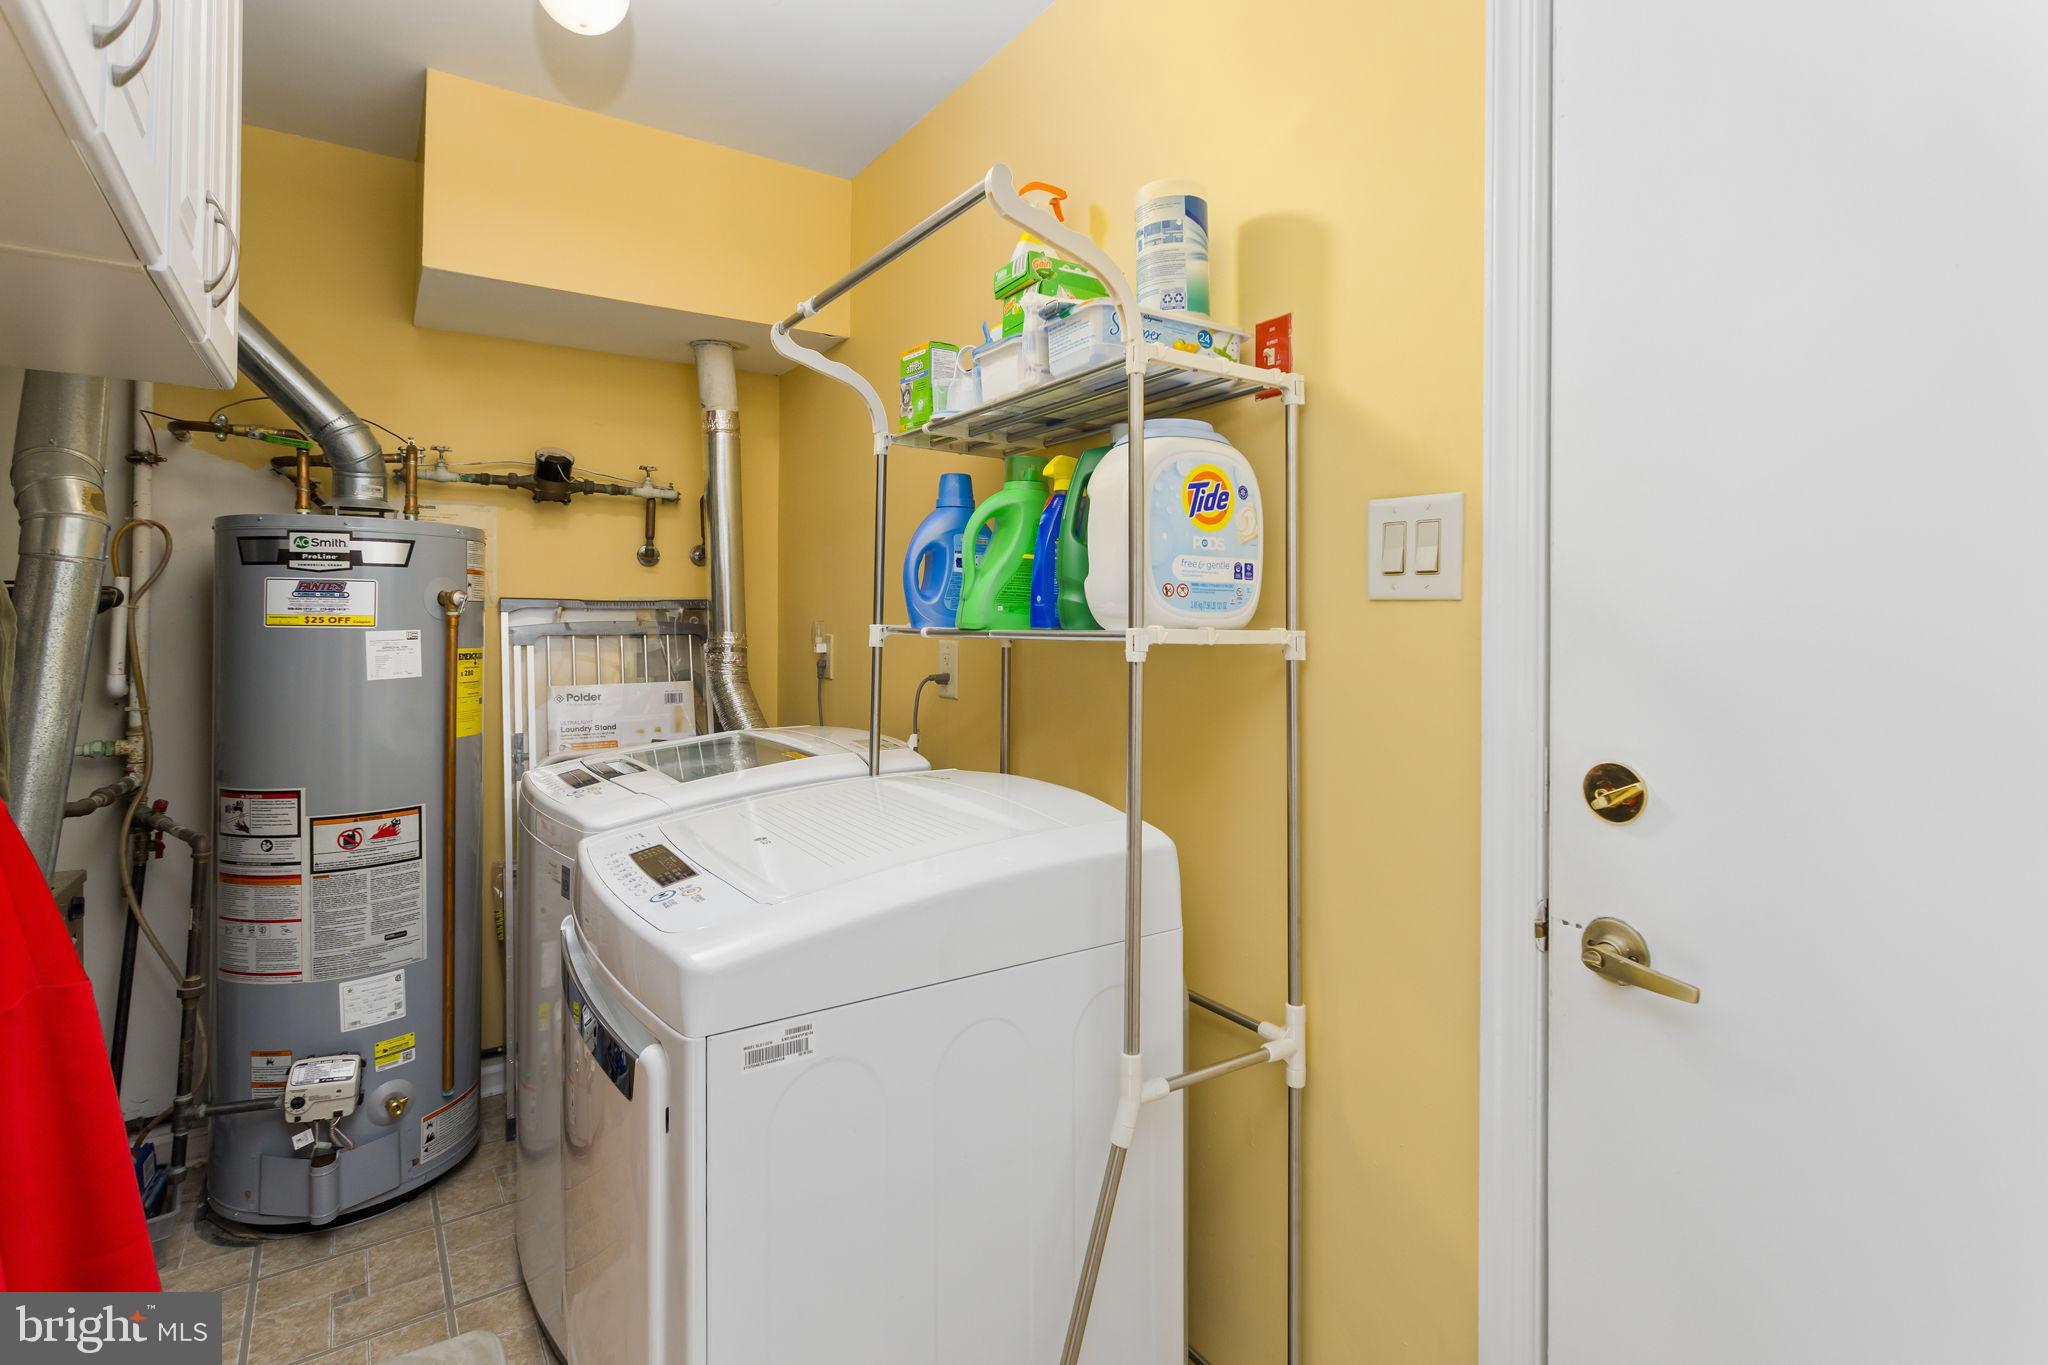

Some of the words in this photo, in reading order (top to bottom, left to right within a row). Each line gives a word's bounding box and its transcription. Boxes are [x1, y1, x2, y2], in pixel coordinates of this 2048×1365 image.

[1032, 259, 1052, 270] Gain
[1199, 332, 1210, 344] 24
[1187, 481, 1230, 519] Tide
[311, 537, 347, 548] Smith
[1181, 559, 1198, 568] free
[1206, 560, 1230, 571] gentle
[304, 615, 325, 625] $25
[328, 616, 351, 624] OFF
[566, 692, 602, 702] Polder
[560, 725, 592, 733] Laundry
[594, 723, 617, 731] Stand
